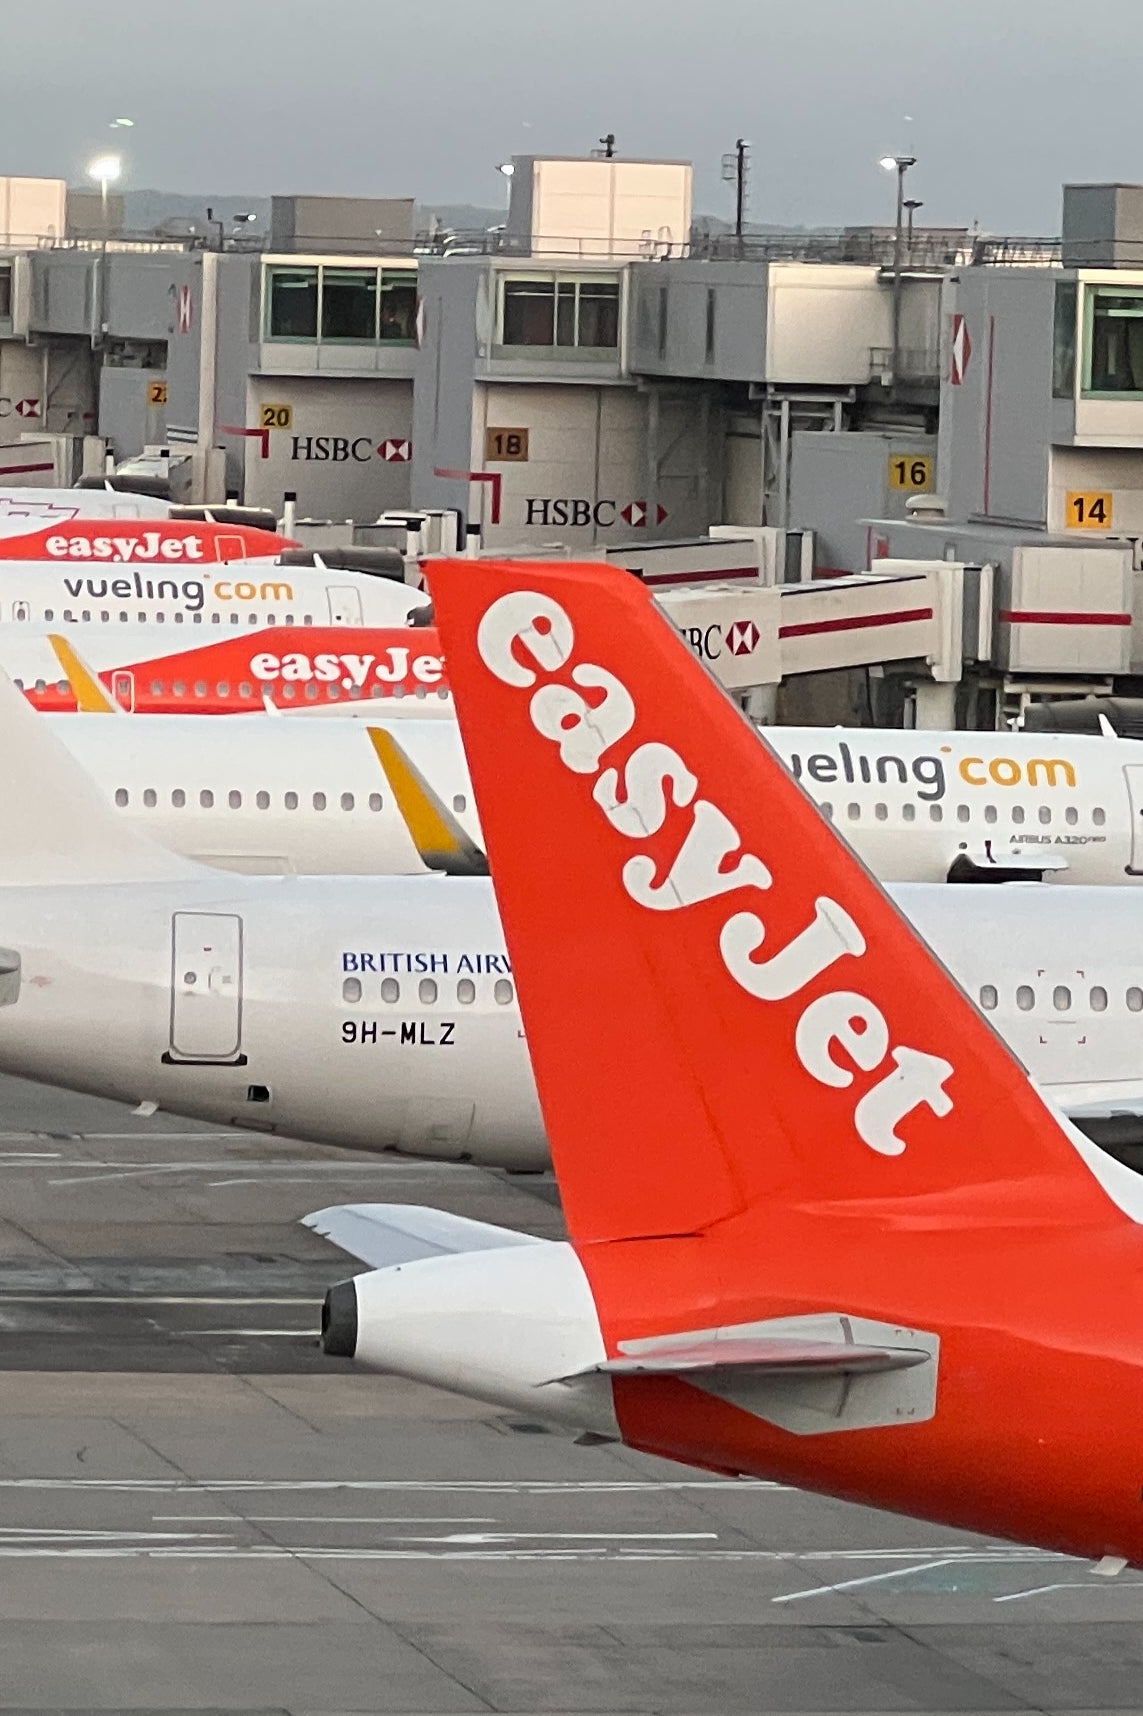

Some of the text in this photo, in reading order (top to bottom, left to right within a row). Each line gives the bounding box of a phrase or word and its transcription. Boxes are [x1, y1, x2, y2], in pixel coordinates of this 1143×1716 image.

[151, 386, 168, 403] 2
[263, 408, 290, 427] 20
[291, 436, 372, 462] HSBC
[495, 434, 521, 455] 18
[895, 461, 926, 486] 16
[525, 498, 616, 527] HSBC
[1073, 497, 1106, 524] 14
[45, 532, 204, 562] easyJet
[679, 624, 722, 659] BC
[250, 647, 446, 690] easyJe
[477, 590, 954, 1156] easyJet
[343, 952, 449, 973] BRITISH
[342, 1020, 456, 1045] 9H-MLZ
